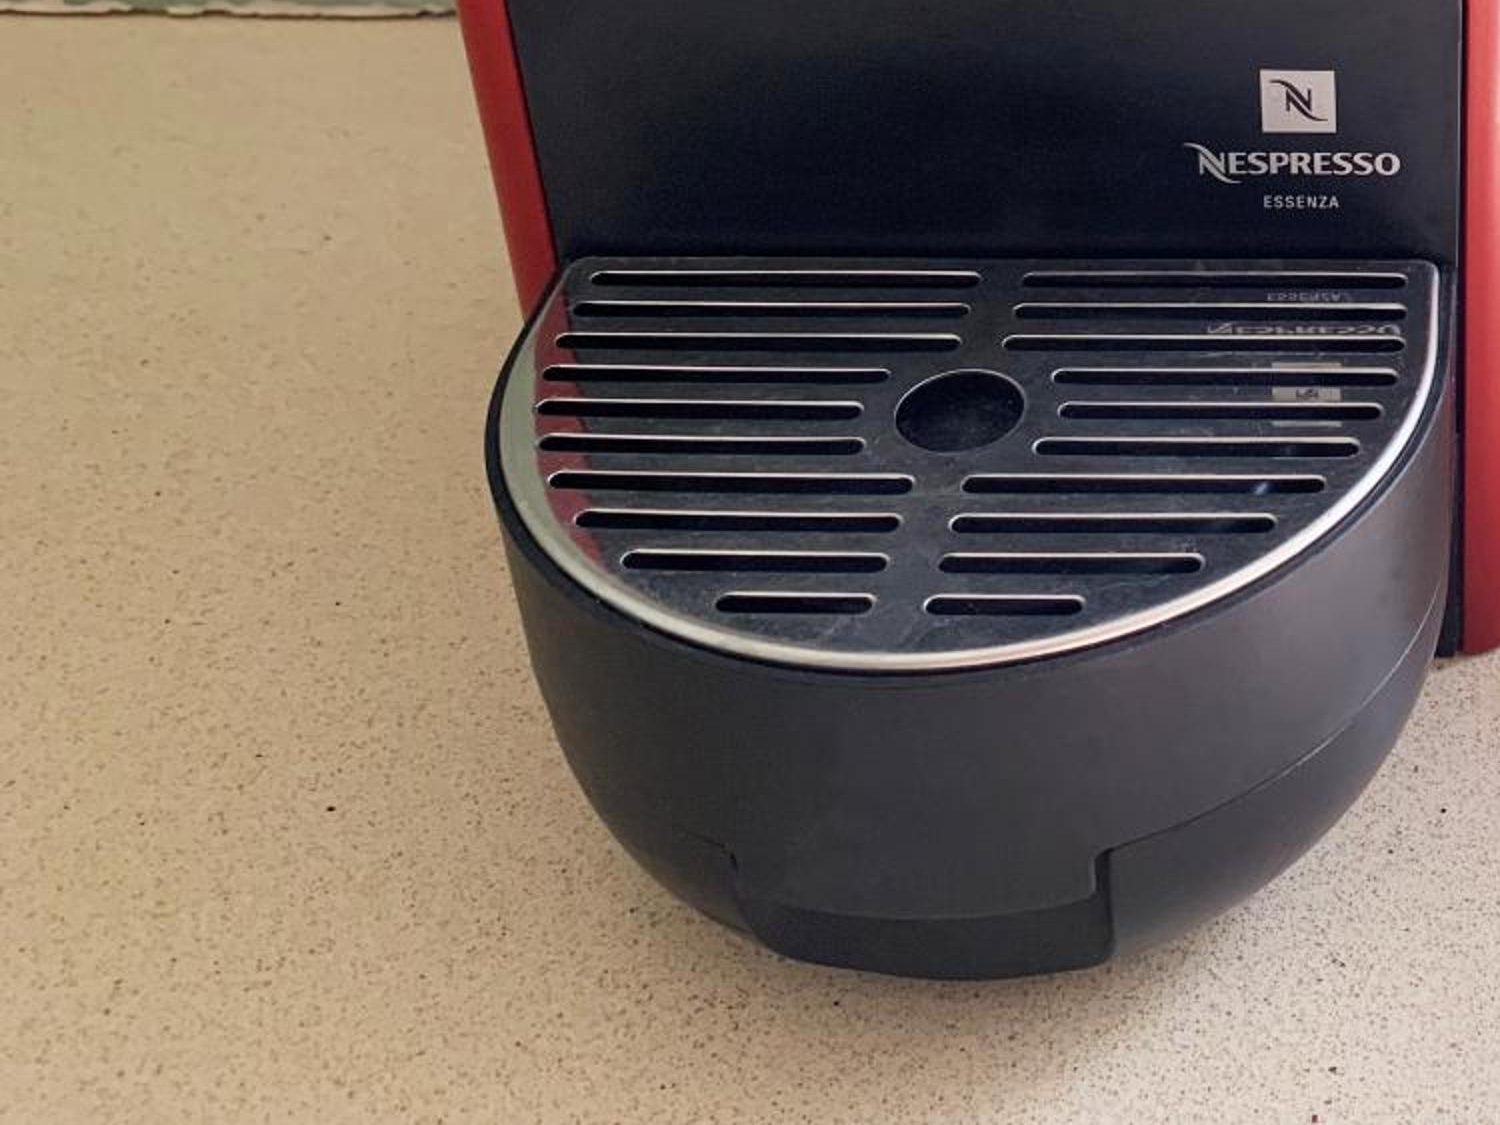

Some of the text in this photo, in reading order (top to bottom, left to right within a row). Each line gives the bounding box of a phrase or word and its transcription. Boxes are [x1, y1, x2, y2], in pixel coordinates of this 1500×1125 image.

[1270, 79, 1329, 122] N
[1184, 142, 1401, 184] NESPRESSO
[1263, 195, 1340, 209] ESSENZA
